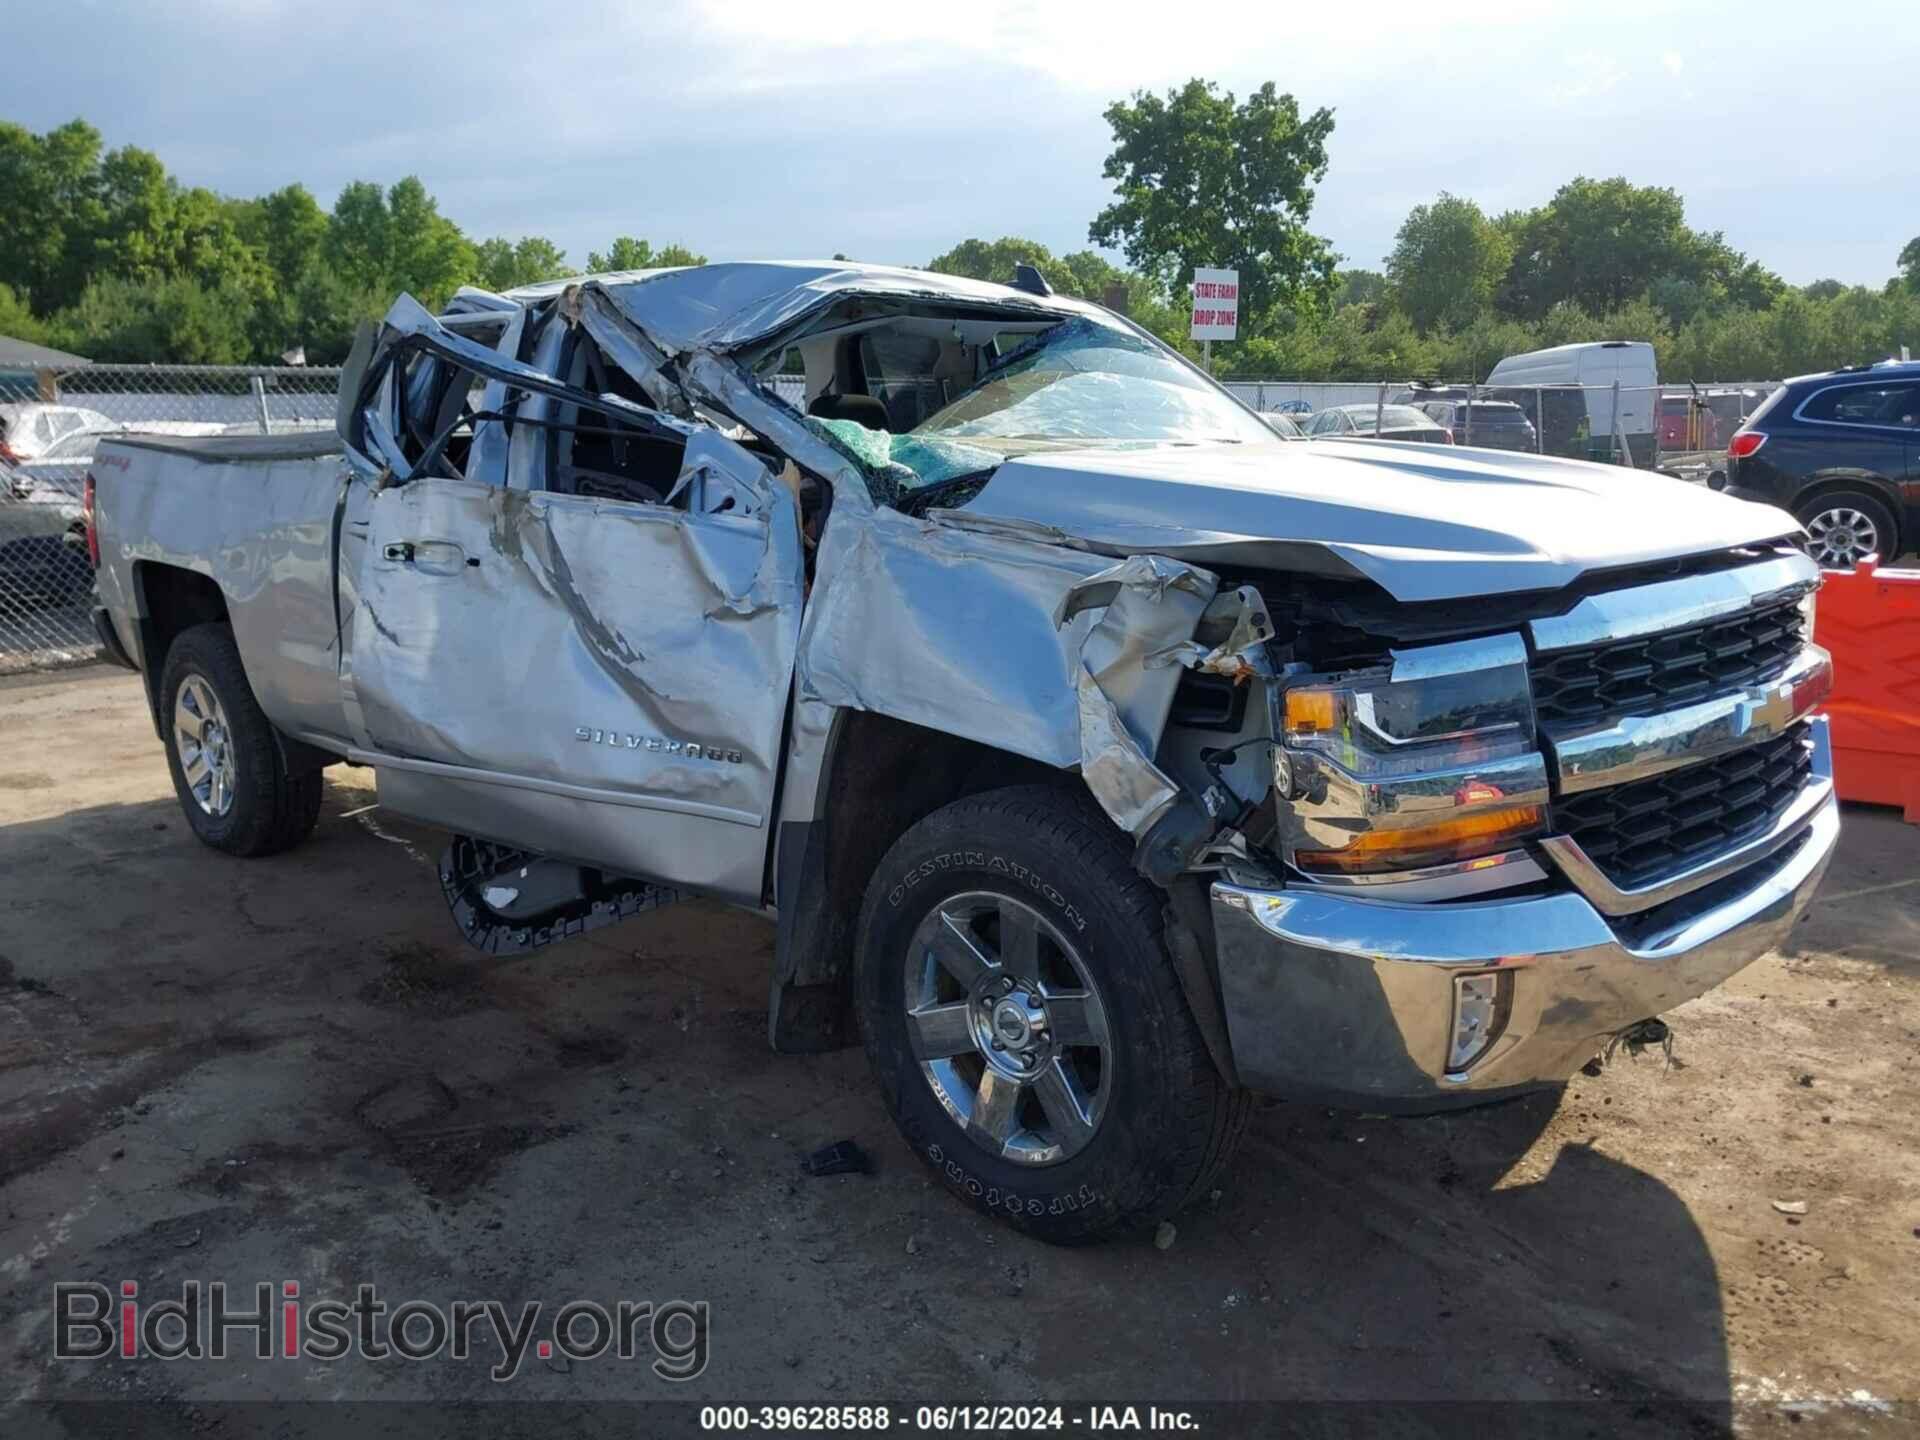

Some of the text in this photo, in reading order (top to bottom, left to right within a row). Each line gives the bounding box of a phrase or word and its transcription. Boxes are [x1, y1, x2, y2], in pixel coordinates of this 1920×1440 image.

[1195, 282, 1237, 299] STATE FARM
[1194, 310, 1235, 326] DROP ZONE
[575, 726, 744, 764] SILVERADO
[888, 850, 1089, 932] DESTINATION
